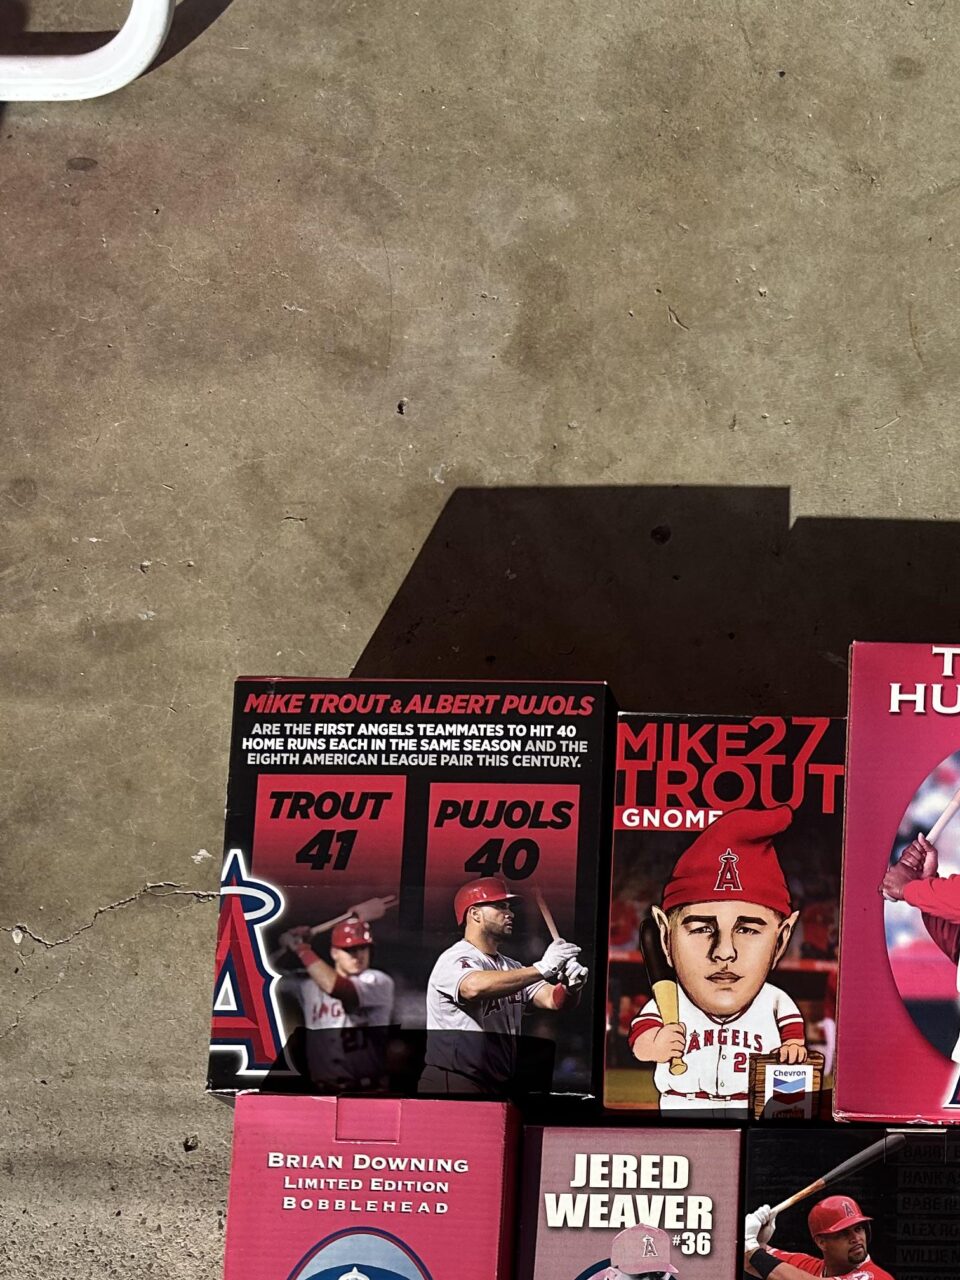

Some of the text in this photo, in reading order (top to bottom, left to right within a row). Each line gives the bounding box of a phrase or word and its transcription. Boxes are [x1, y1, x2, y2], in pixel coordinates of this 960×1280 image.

[243, 693, 594, 716] MIKE TROUT & ALBERT PUJOLS
[252, 723, 576, 738] ARE THE FIRST ANGELS TEAMMATES TO HIT 40
[242, 737, 588, 753] HOME RUNS EACH IN THE SAME SEASON AND THE
[247, 752, 582, 768] EIGHTH AMERICAN LEAGUE PAIR THIS CENTURY.
[614, 760, 845, 814] TROUT
[269, 791, 393, 820] TROUT
[434, 800, 574, 830] PUJOLS
[295, 829, 357, 871] 41
[464, 838, 541, 880] 40
[686, 1028, 763, 1054] ANGELS
[773, 1069, 807, 1077] Chevron
[569, 1153, 690, 1190] JERED
[282, 1196, 450, 1215] BOBBLEHEAD
[543, 1193, 714, 1231] WEAVER
[671, 1233, 712, 1256] #36
